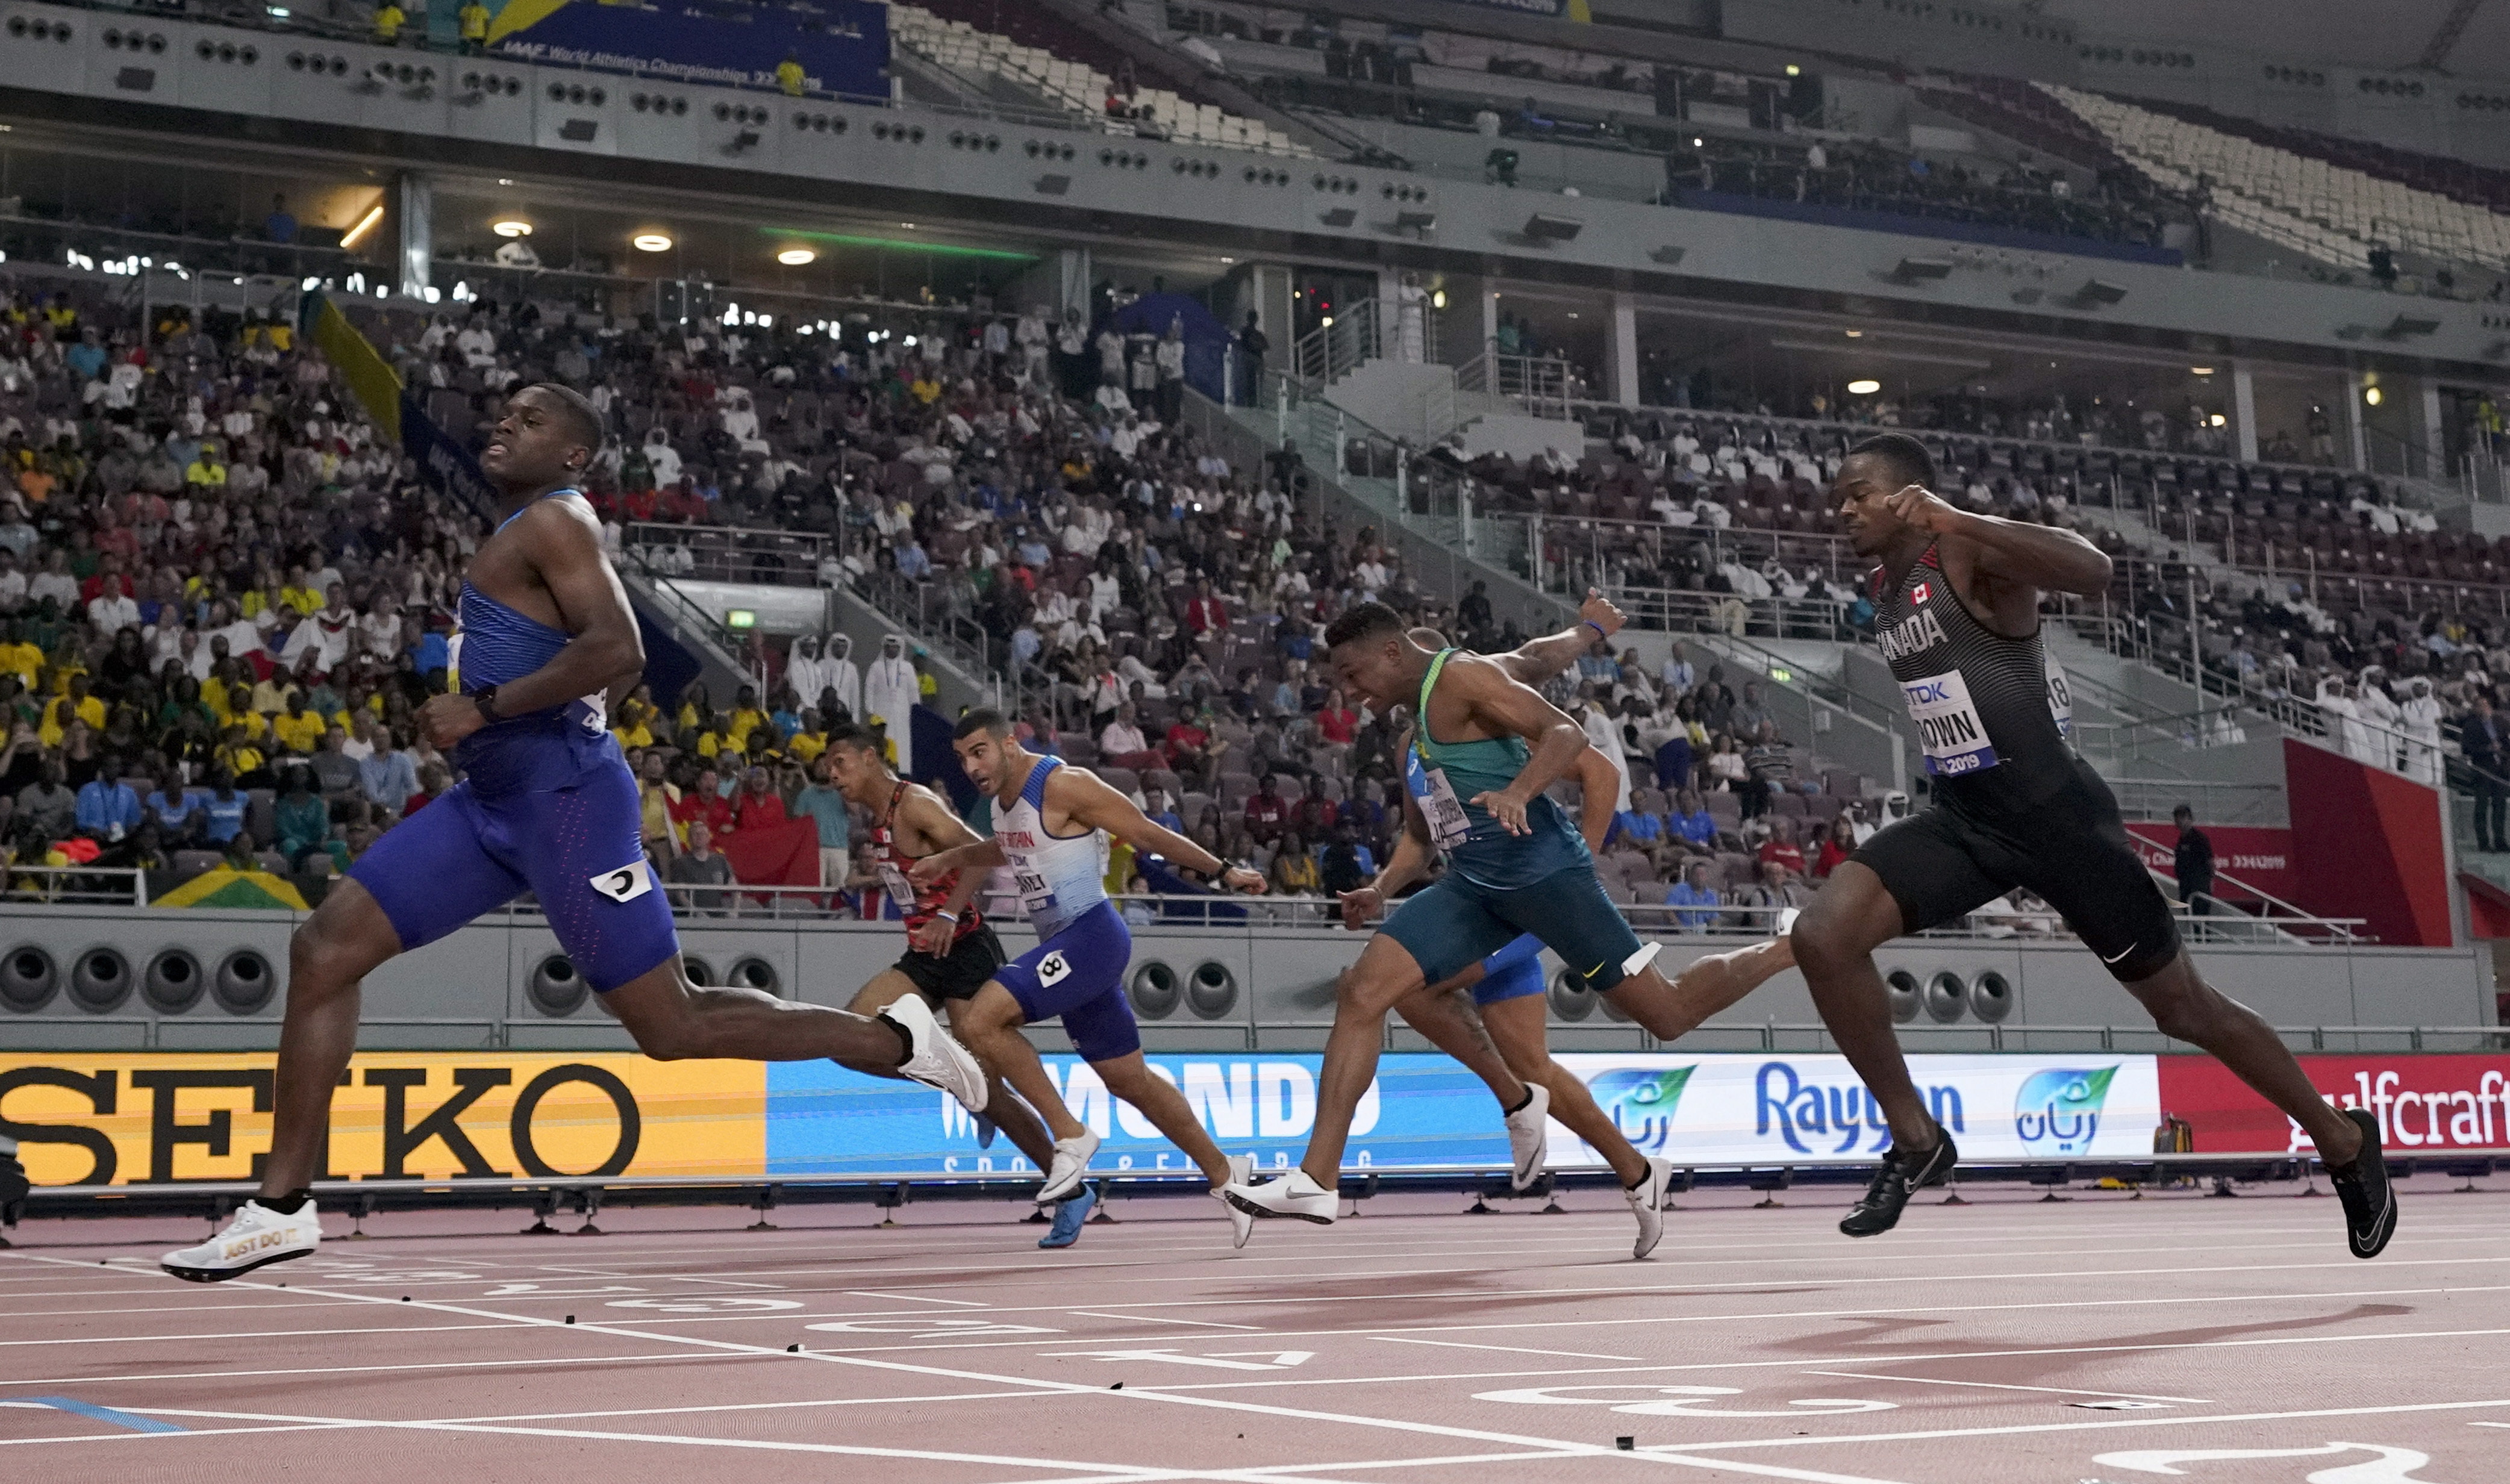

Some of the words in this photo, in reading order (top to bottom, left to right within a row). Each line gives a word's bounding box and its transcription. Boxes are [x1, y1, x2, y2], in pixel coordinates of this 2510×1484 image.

[549, 45, 588, 61] World
[1876, 608, 1949, 661] ANADA
[1905, 682, 1950, 705] TDK
[1042, 957, 1062, 977] 8
[1756, 1061, 1965, 1154] Rayyn
[2287, 1070, 2510, 1153] lfcraf
[224, 1237, 256, 1261] JUST
[260, 1231, 283, 1249] DO
